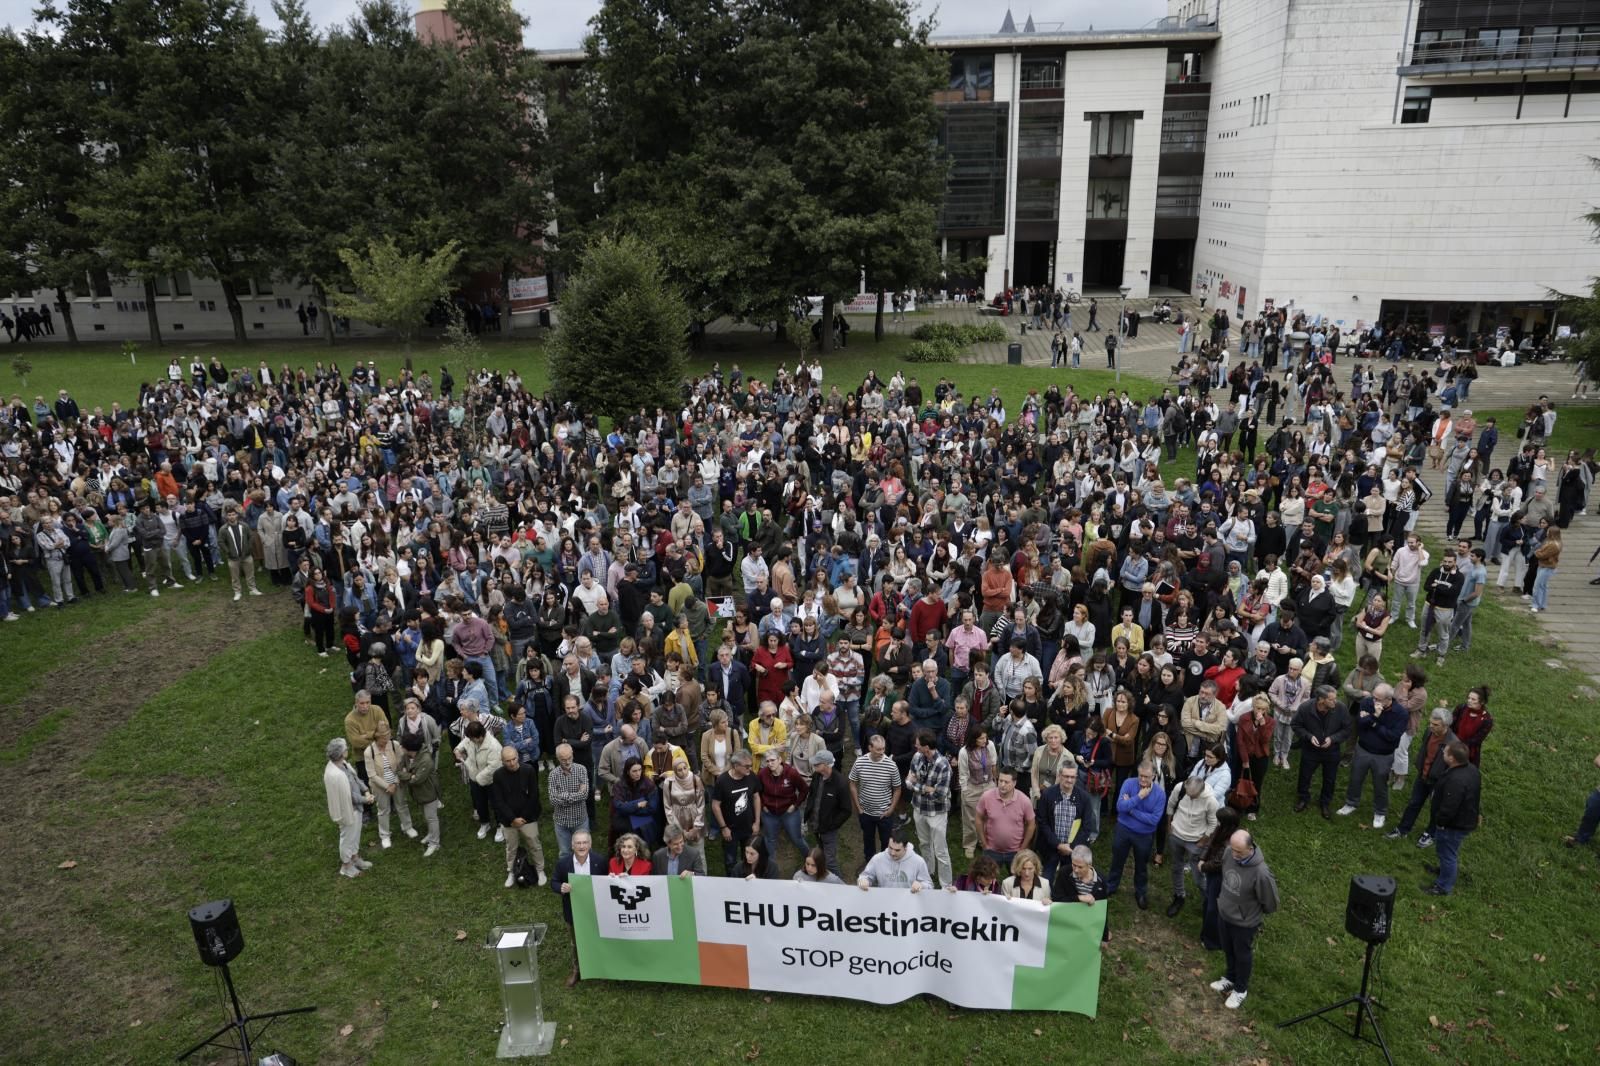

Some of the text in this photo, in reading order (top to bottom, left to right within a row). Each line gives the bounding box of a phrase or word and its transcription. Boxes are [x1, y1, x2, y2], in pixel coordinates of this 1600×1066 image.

[618, 913, 650, 924] EHU
[724, 900, 1020, 942] EHU Palestinarekin
[782, 947, 953, 976] STOP genocide
